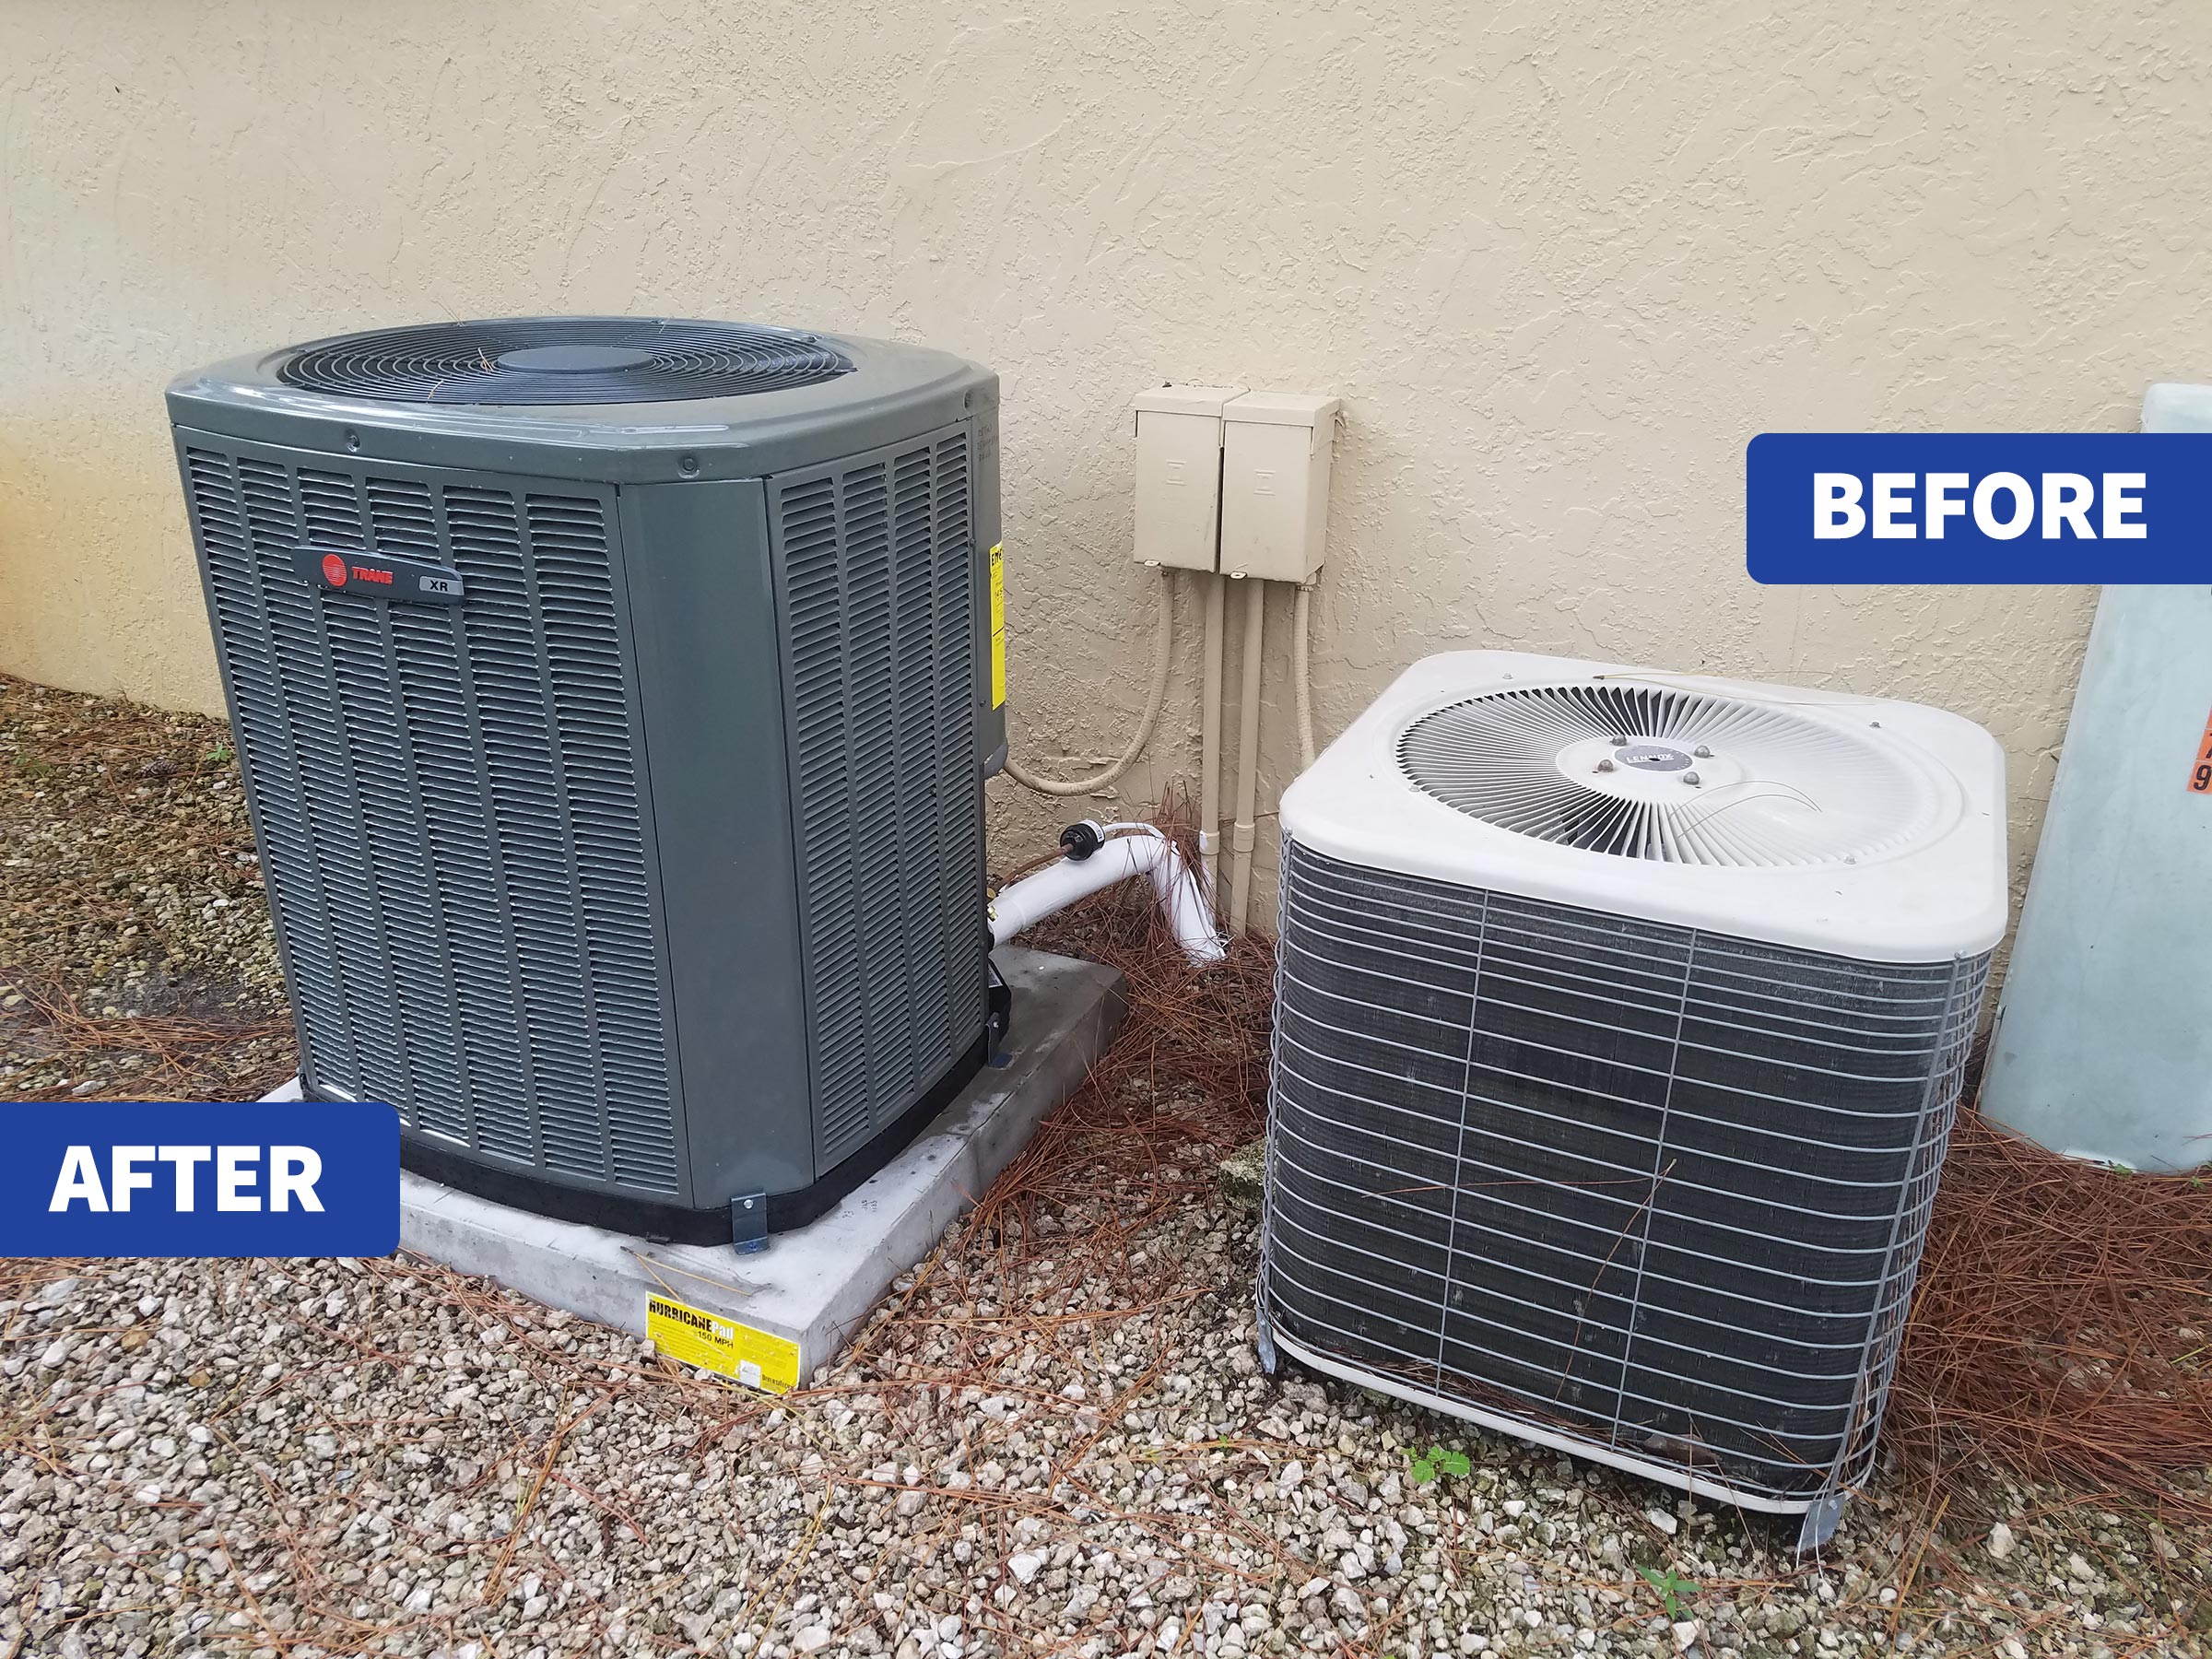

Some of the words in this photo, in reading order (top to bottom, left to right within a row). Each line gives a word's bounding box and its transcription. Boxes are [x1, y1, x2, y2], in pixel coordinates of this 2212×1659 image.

[351, 566, 394, 585] TRANE
[429, 580, 449, 593] XR
[1626, 753, 1675, 764] LENNOX
[698, 1330, 712, 1342] 150
[714, 1336, 734, 1349] MPH
